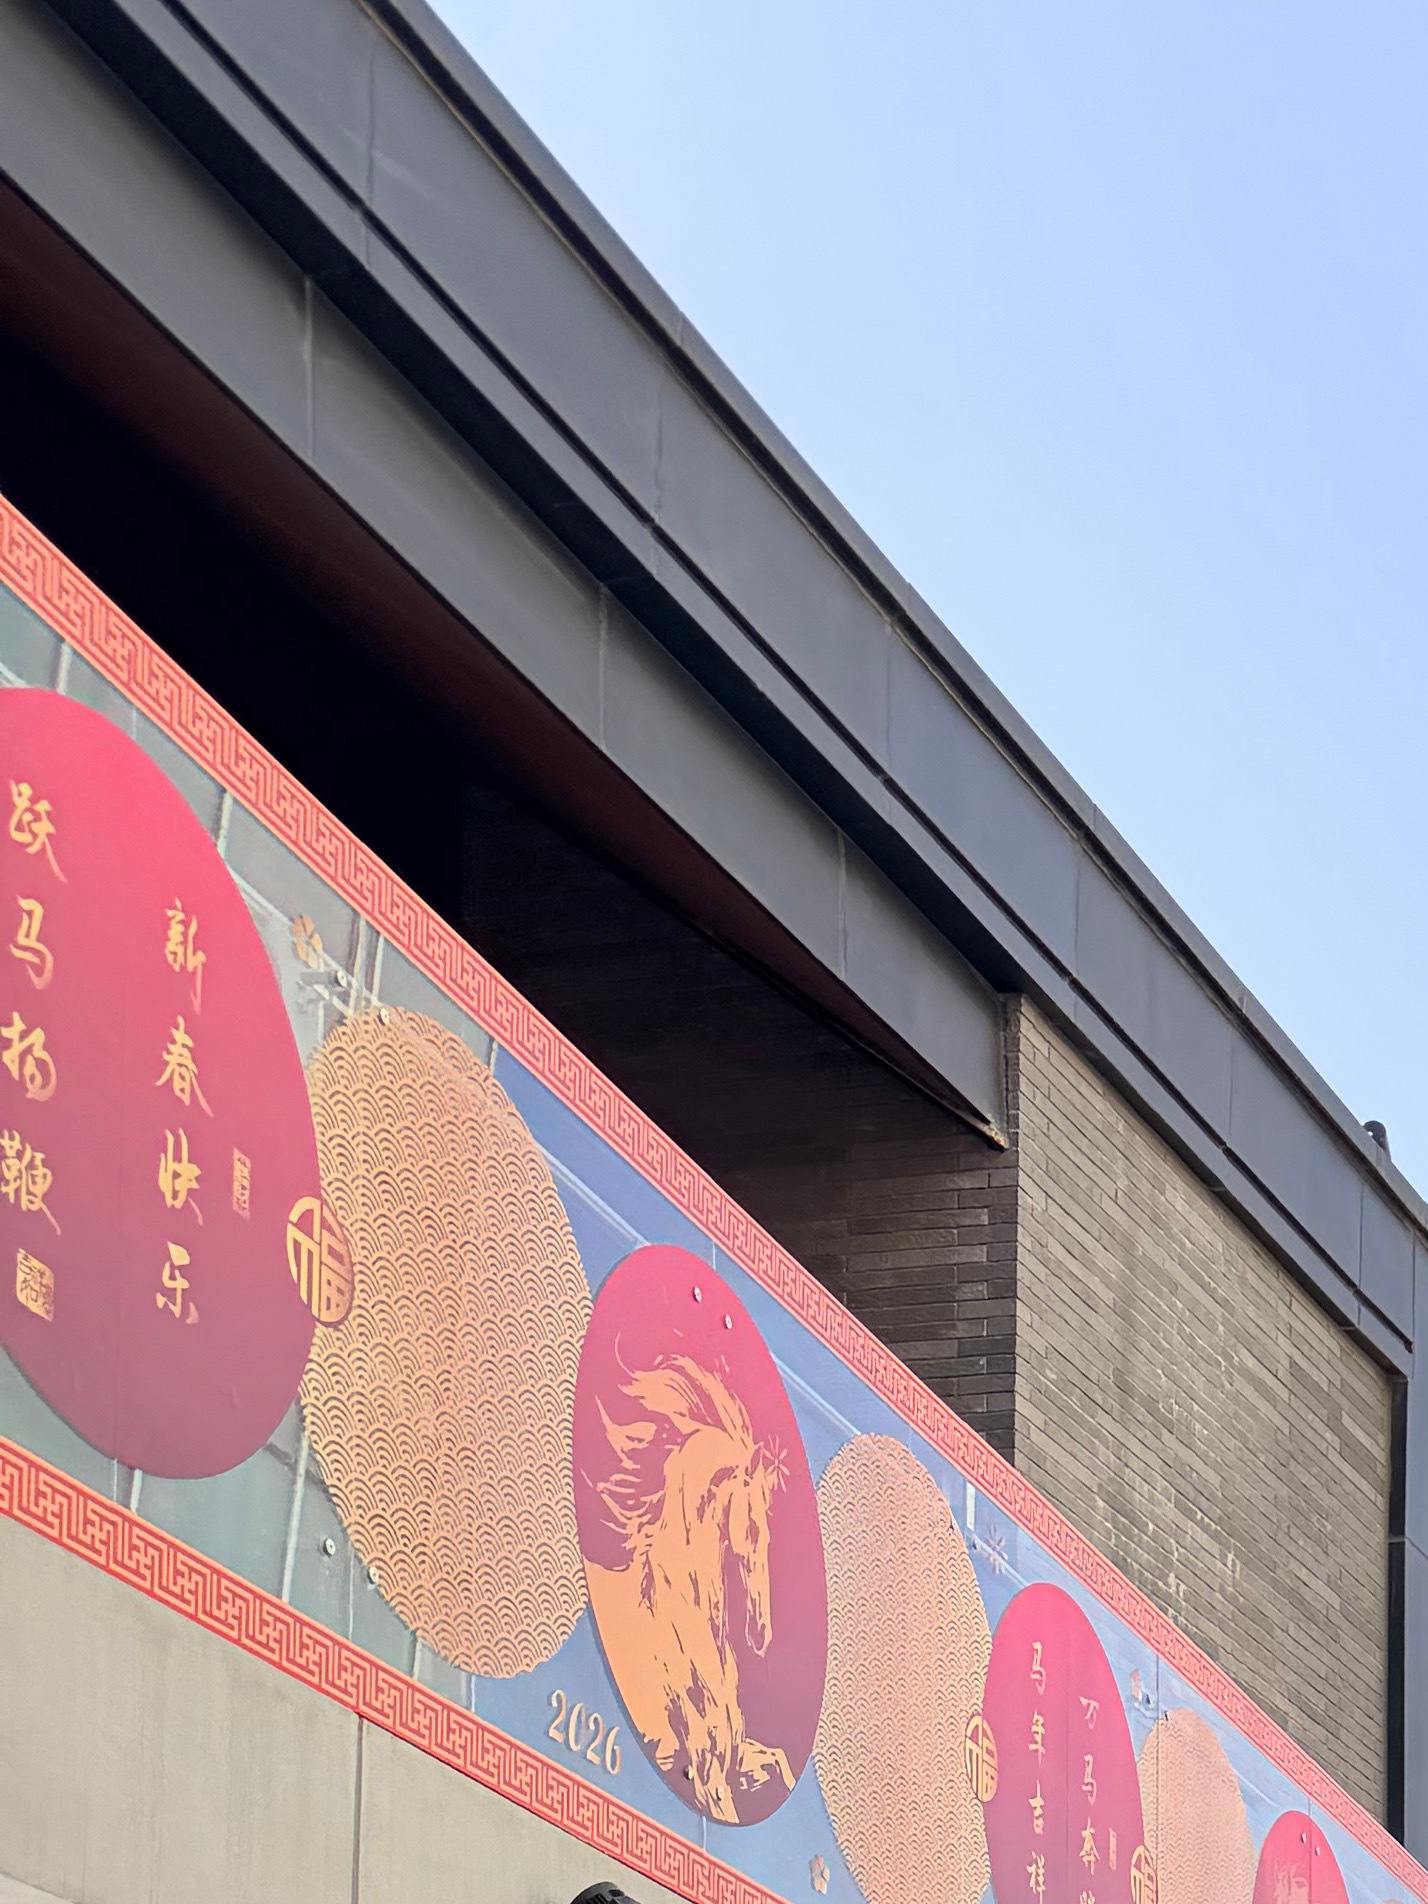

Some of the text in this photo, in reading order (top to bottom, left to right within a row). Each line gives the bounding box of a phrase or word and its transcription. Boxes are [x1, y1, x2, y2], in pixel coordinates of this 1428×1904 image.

[0, 779, 68, 1237] 跃马扬鞭
[155, 899, 212, 1324] 新春快乐
[548, 1689, 621, 1776] 2026
